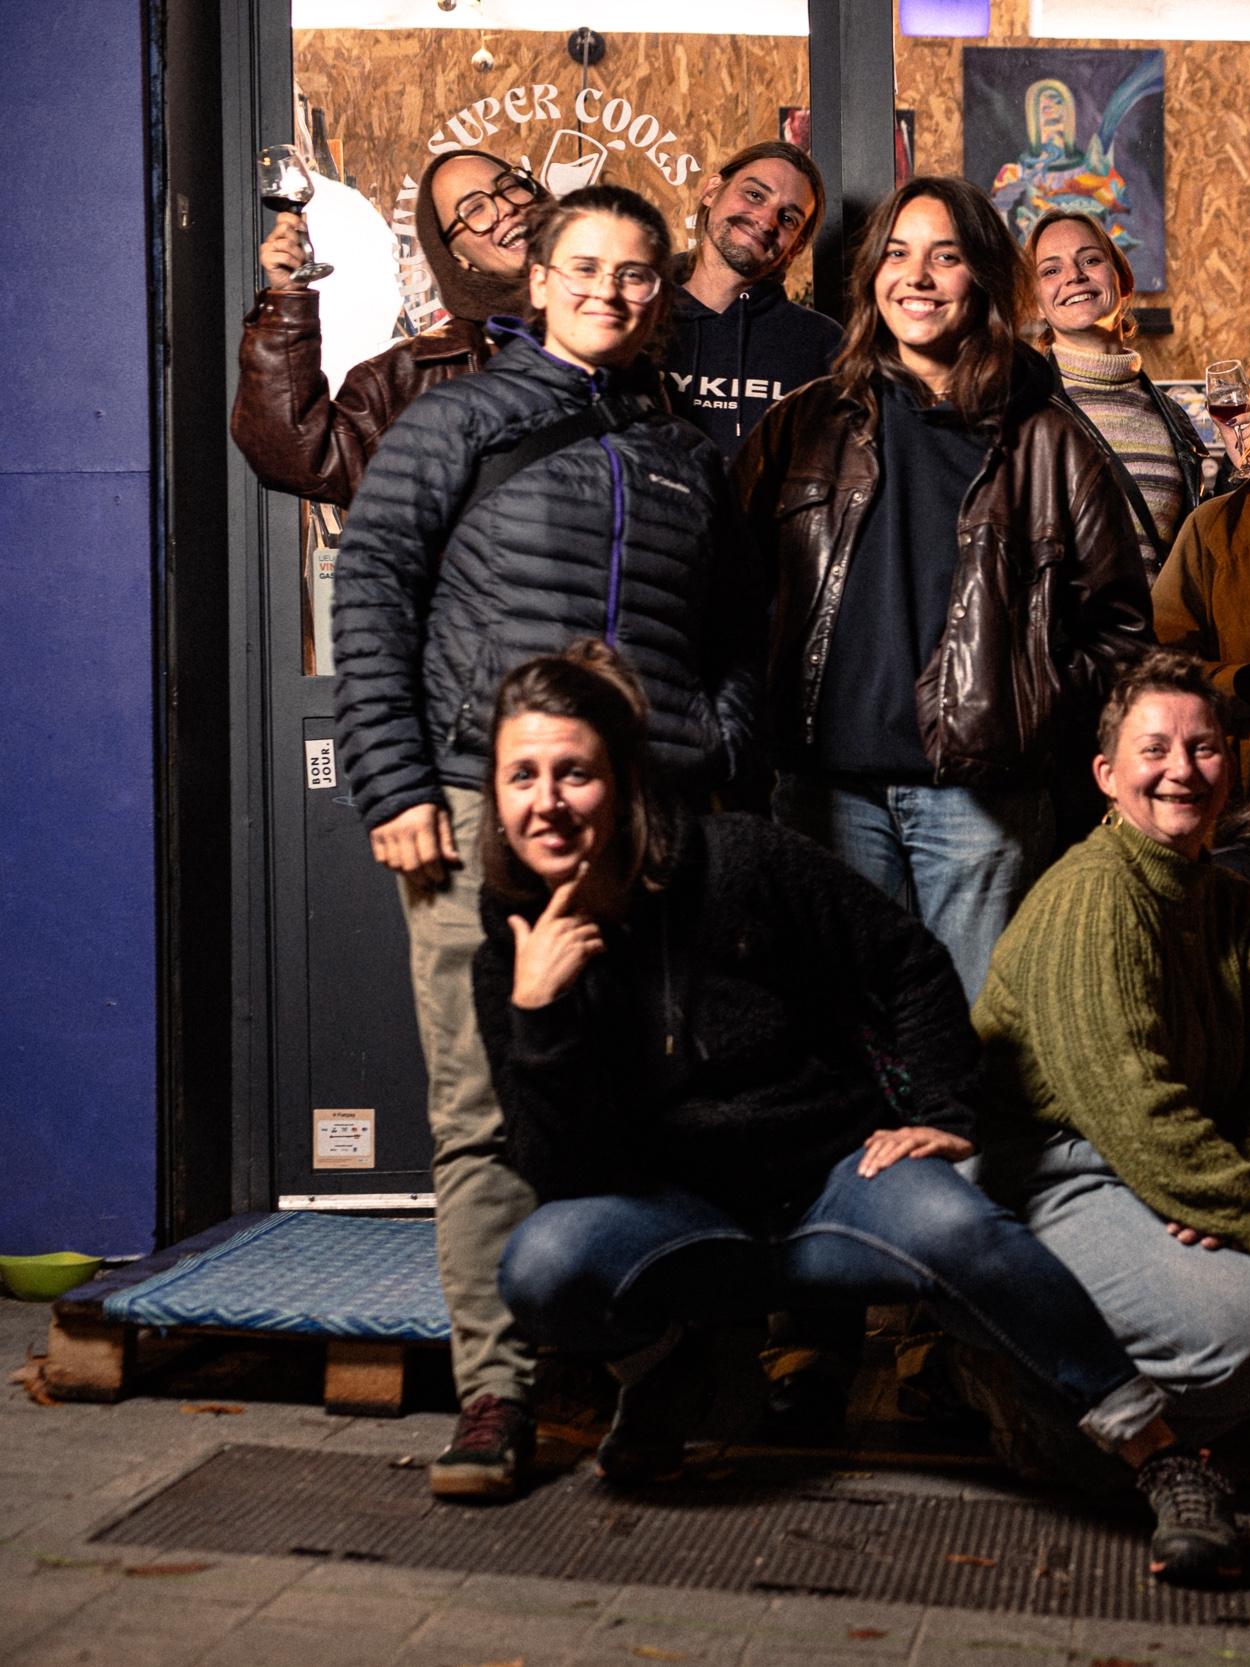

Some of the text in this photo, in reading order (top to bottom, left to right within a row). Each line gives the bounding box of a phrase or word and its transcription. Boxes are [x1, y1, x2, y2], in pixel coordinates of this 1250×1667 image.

[427, 84, 701, 186] SUPER COOLS
[658, 370, 786, 401] YKIEL
[693, 399, 738, 410] PARIS
[310, 757, 321, 785] BON
